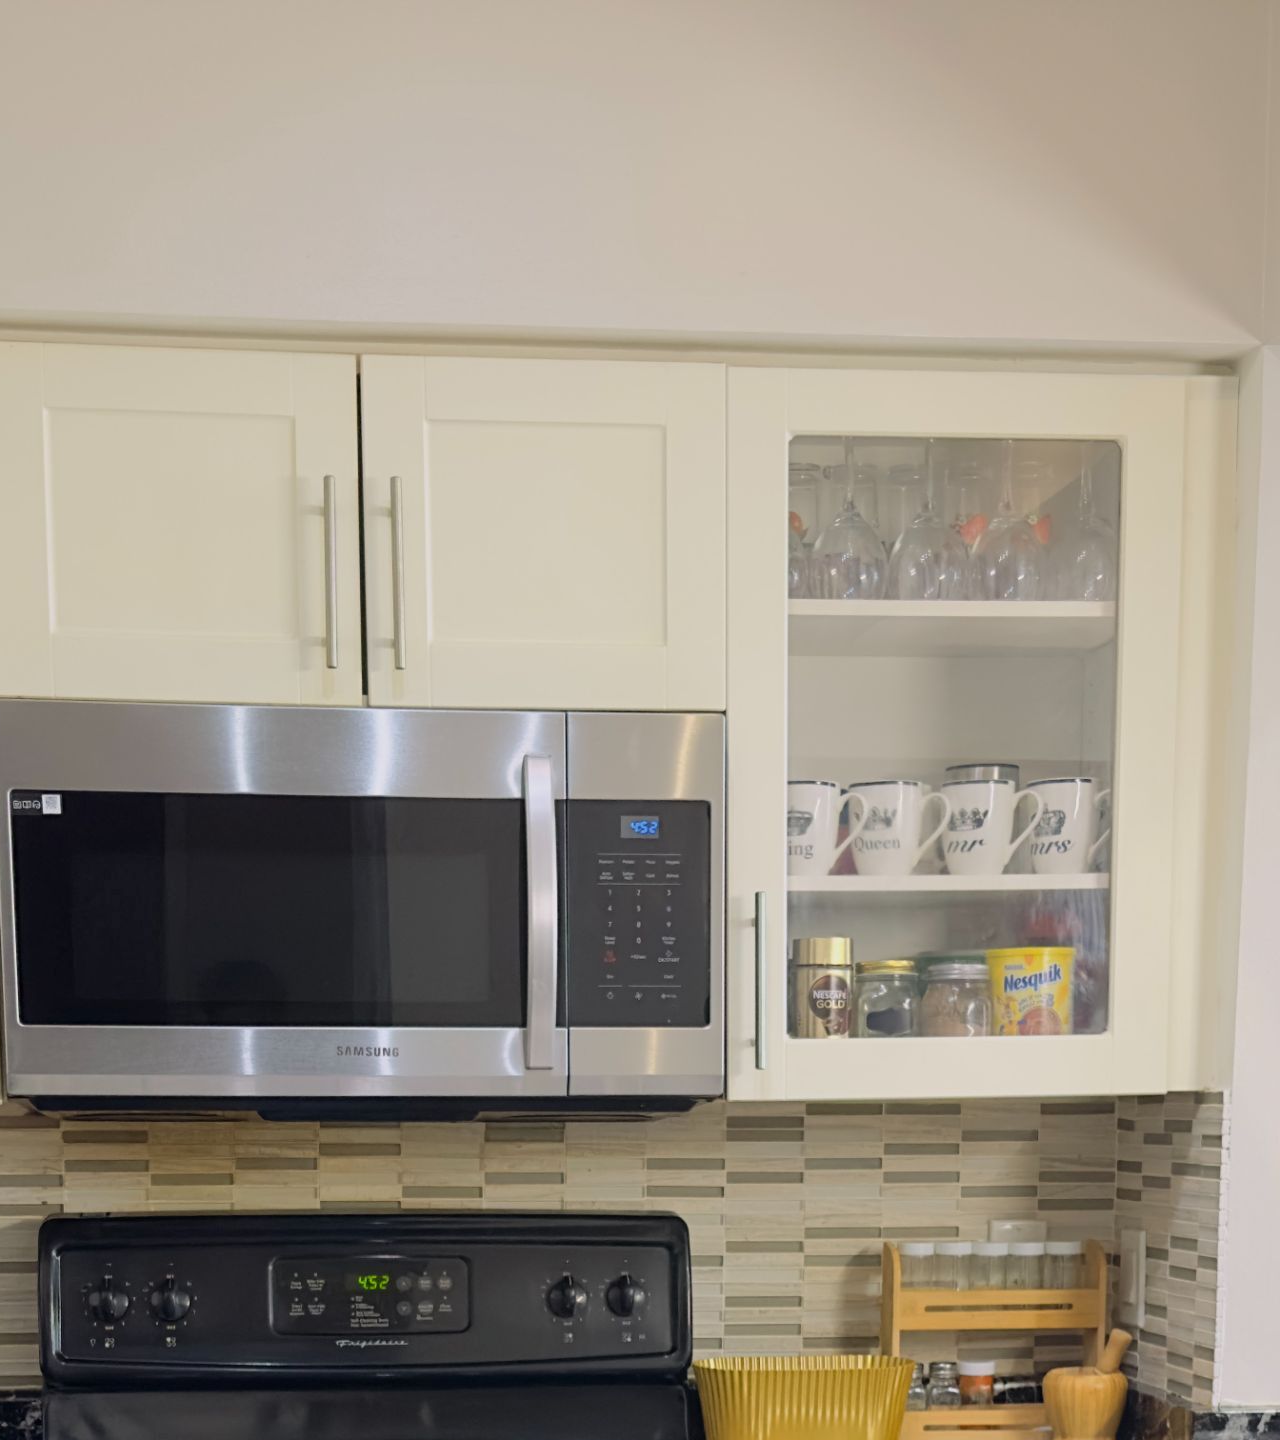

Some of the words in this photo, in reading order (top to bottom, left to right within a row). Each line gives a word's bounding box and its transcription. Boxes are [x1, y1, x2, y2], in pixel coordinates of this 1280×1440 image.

[787, 842, 815, 860] ing
[853, 836, 900, 852] Queen
[1004, 963, 1062, 993] Nesquik
[816, 1000, 846, 1009] GOLD
[336, 1046, 400, 1058] SAMSUNG
[335, 1339, 409, 1349] Frigidaire
